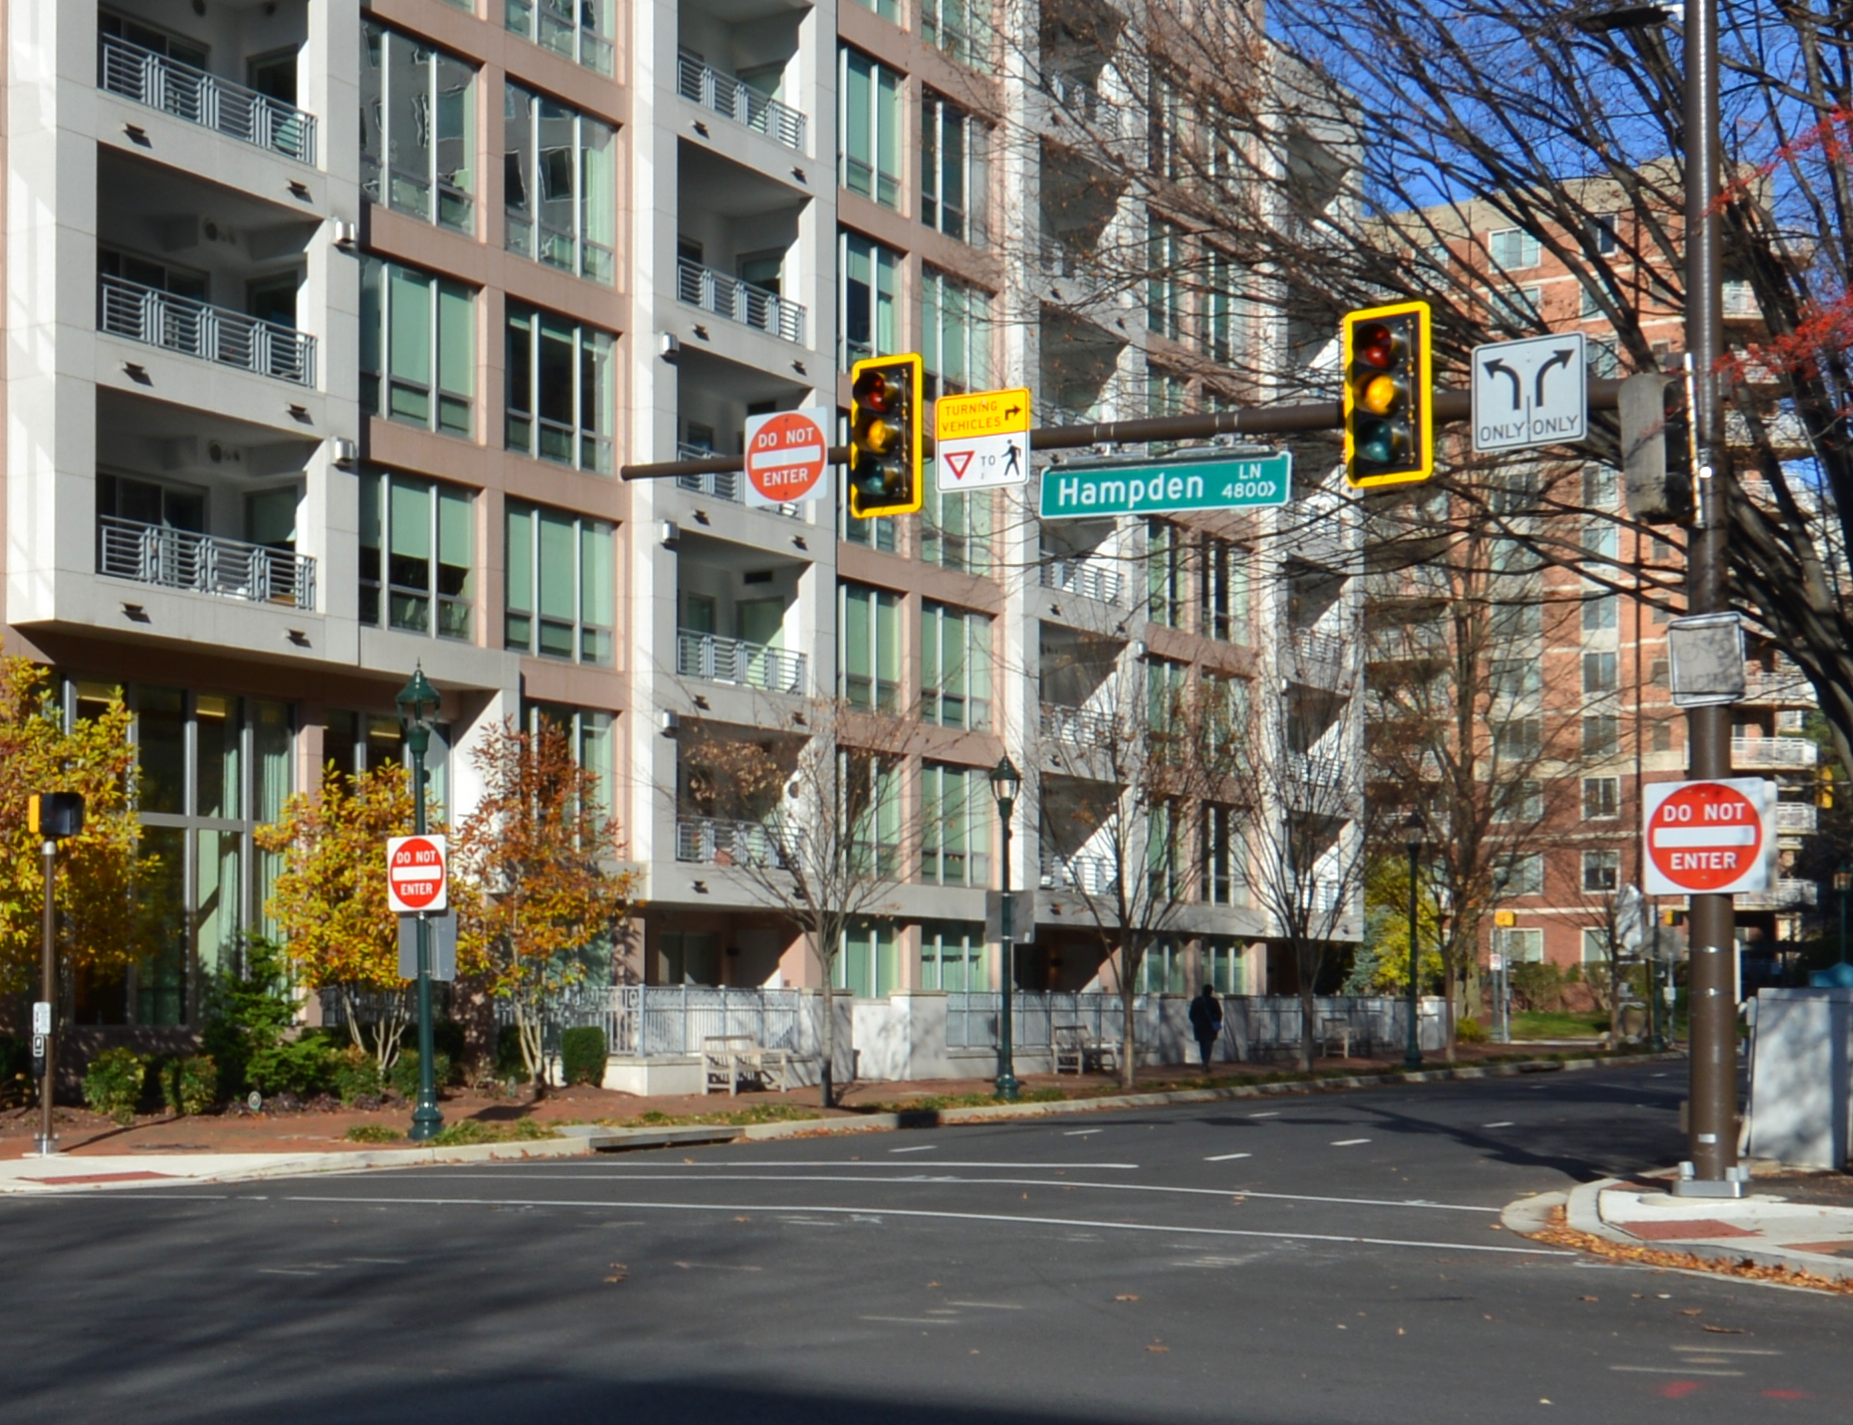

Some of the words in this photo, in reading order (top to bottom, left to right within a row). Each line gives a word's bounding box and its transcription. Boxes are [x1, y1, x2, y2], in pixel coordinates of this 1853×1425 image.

[945, 400, 998, 417] TURNING
[941, 416, 1002, 433] VEHICLES
[1480, 421, 1526, 442] ONLY
[1532, 415, 1579, 436] ONLY
[758, 431, 778, 448] DO
[786, 426, 815, 444] NOT
[980, 454, 996, 466] TO
[763, 467, 809, 487] ENTER
[1058, 472, 1204, 510] Hampden
[1238, 463, 1262, 480] LN
[1221, 482, 1268, 499] 4800
[1663, 804, 1692, 823] DO
[1703, 802, 1746, 821] NOT
[396, 851, 412, 865] DO
[415, 849, 437, 864] NOT
[1670, 851, 1738, 871] ENTER
[400, 882, 434, 896] ENTER
